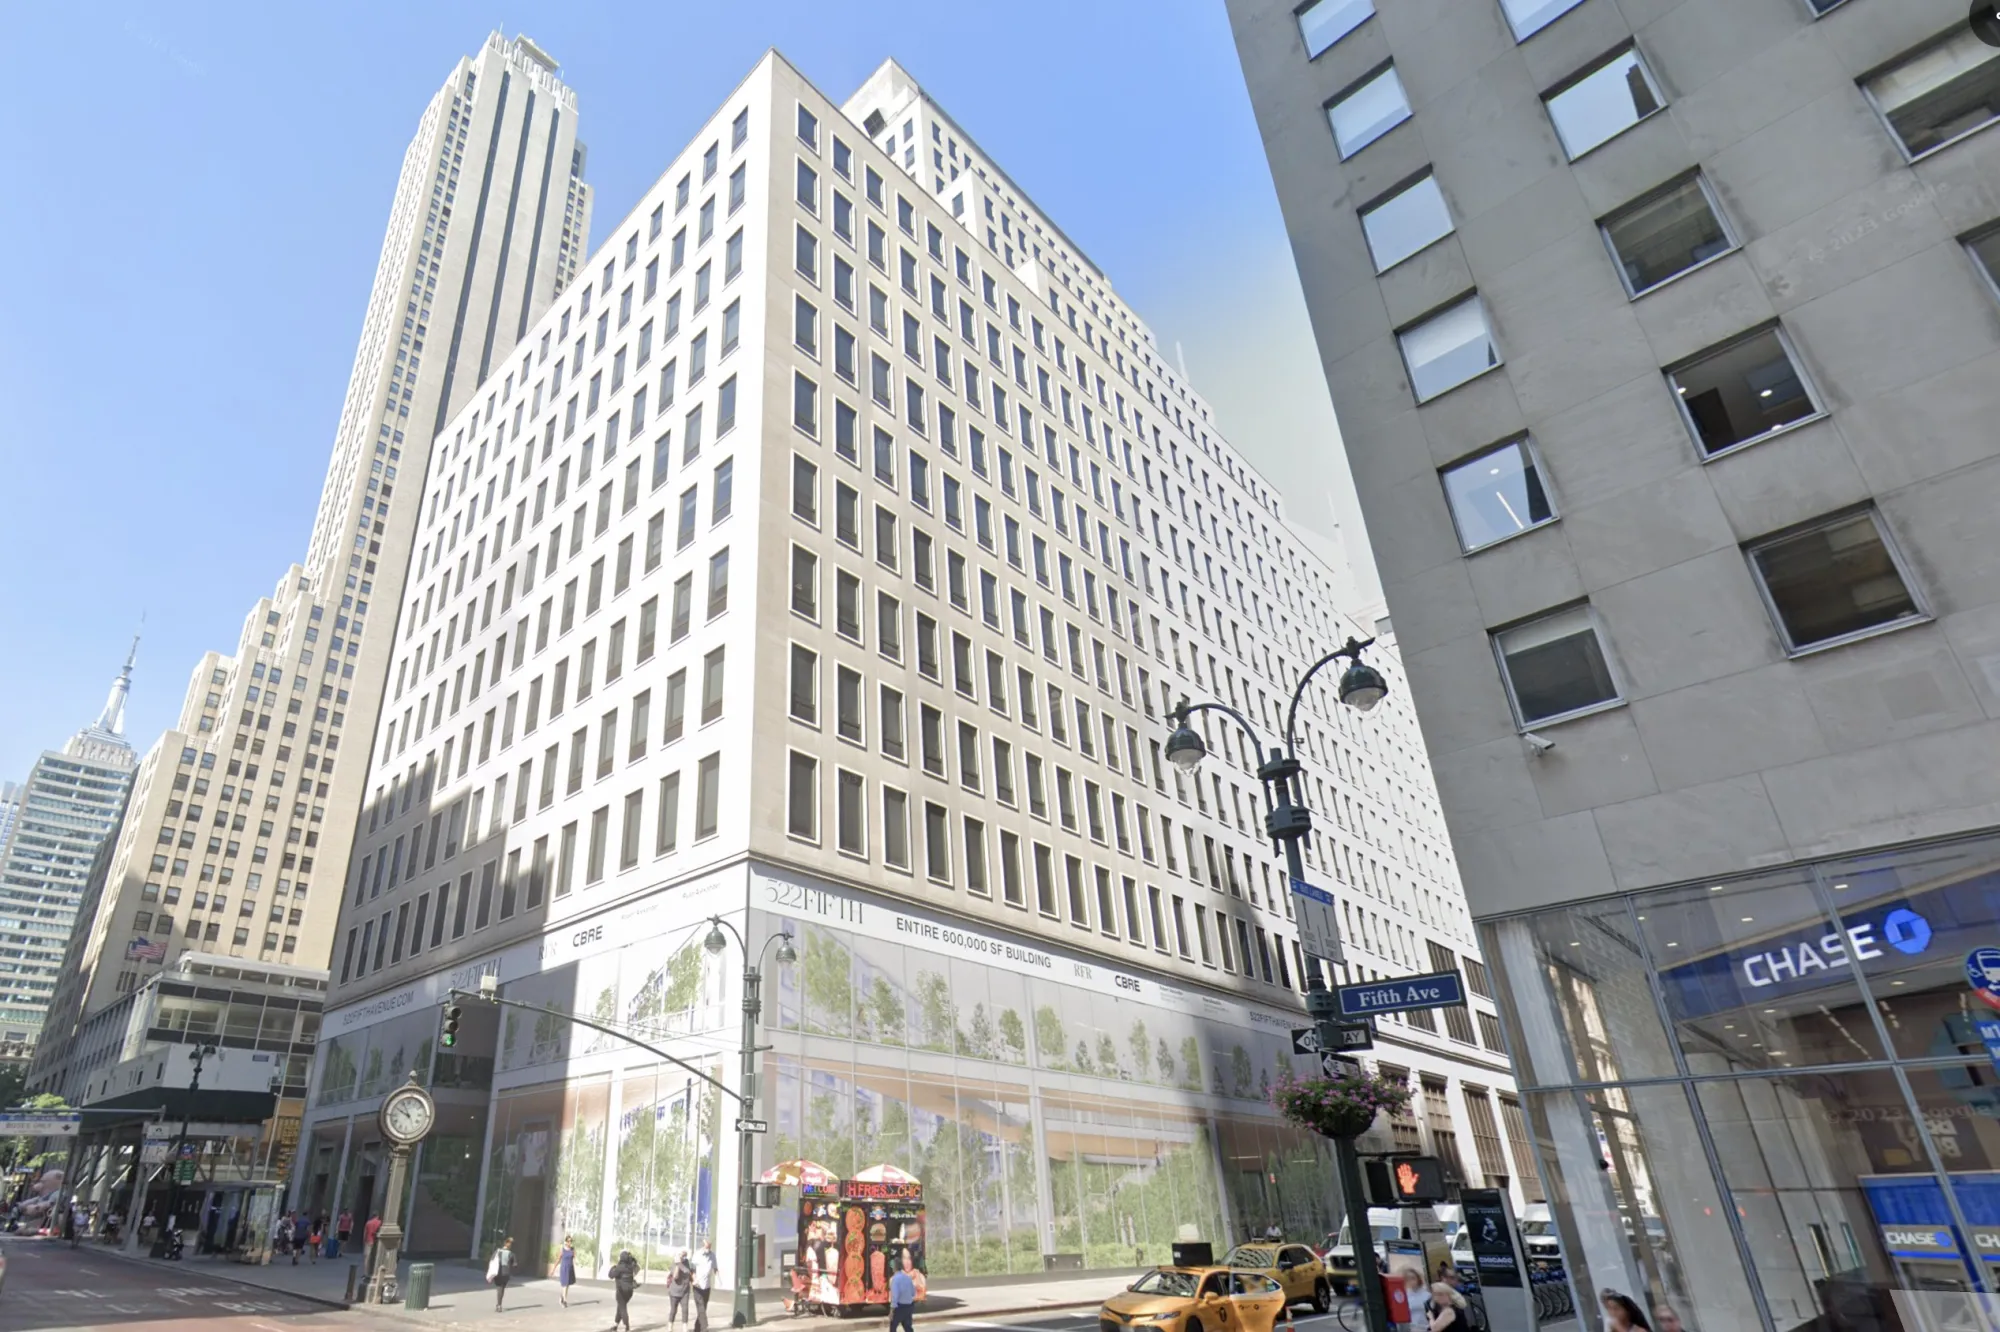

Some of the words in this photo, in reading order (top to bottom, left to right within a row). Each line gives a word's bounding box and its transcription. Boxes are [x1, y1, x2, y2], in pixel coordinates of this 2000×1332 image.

[765, 879, 863, 924] 522FIFTH
[572, 925, 603, 948] CBRE
[896, 917, 939, 940] ENTIRE
[942, 930, 987, 952] 600,000
[990, 943, 1003, 956] SF
[1006, 947, 1052, 968] BUILDING
[1743, 923, 1883, 987] CHASE
[1073, 963, 1092, 980] RFR
[1115, 975, 1141, 993] CBRE
[1358, 987, 1402, 1008] Fifth
[1406, 983, 1441, 1003] Ave
[1303, 1035, 1318, 1047] ON
[1344, 1032, 1360, 1044] AY
[1885, 1231, 1939, 1245] CHASE
[1478, 1256, 1513, 1264] CHICAGO
